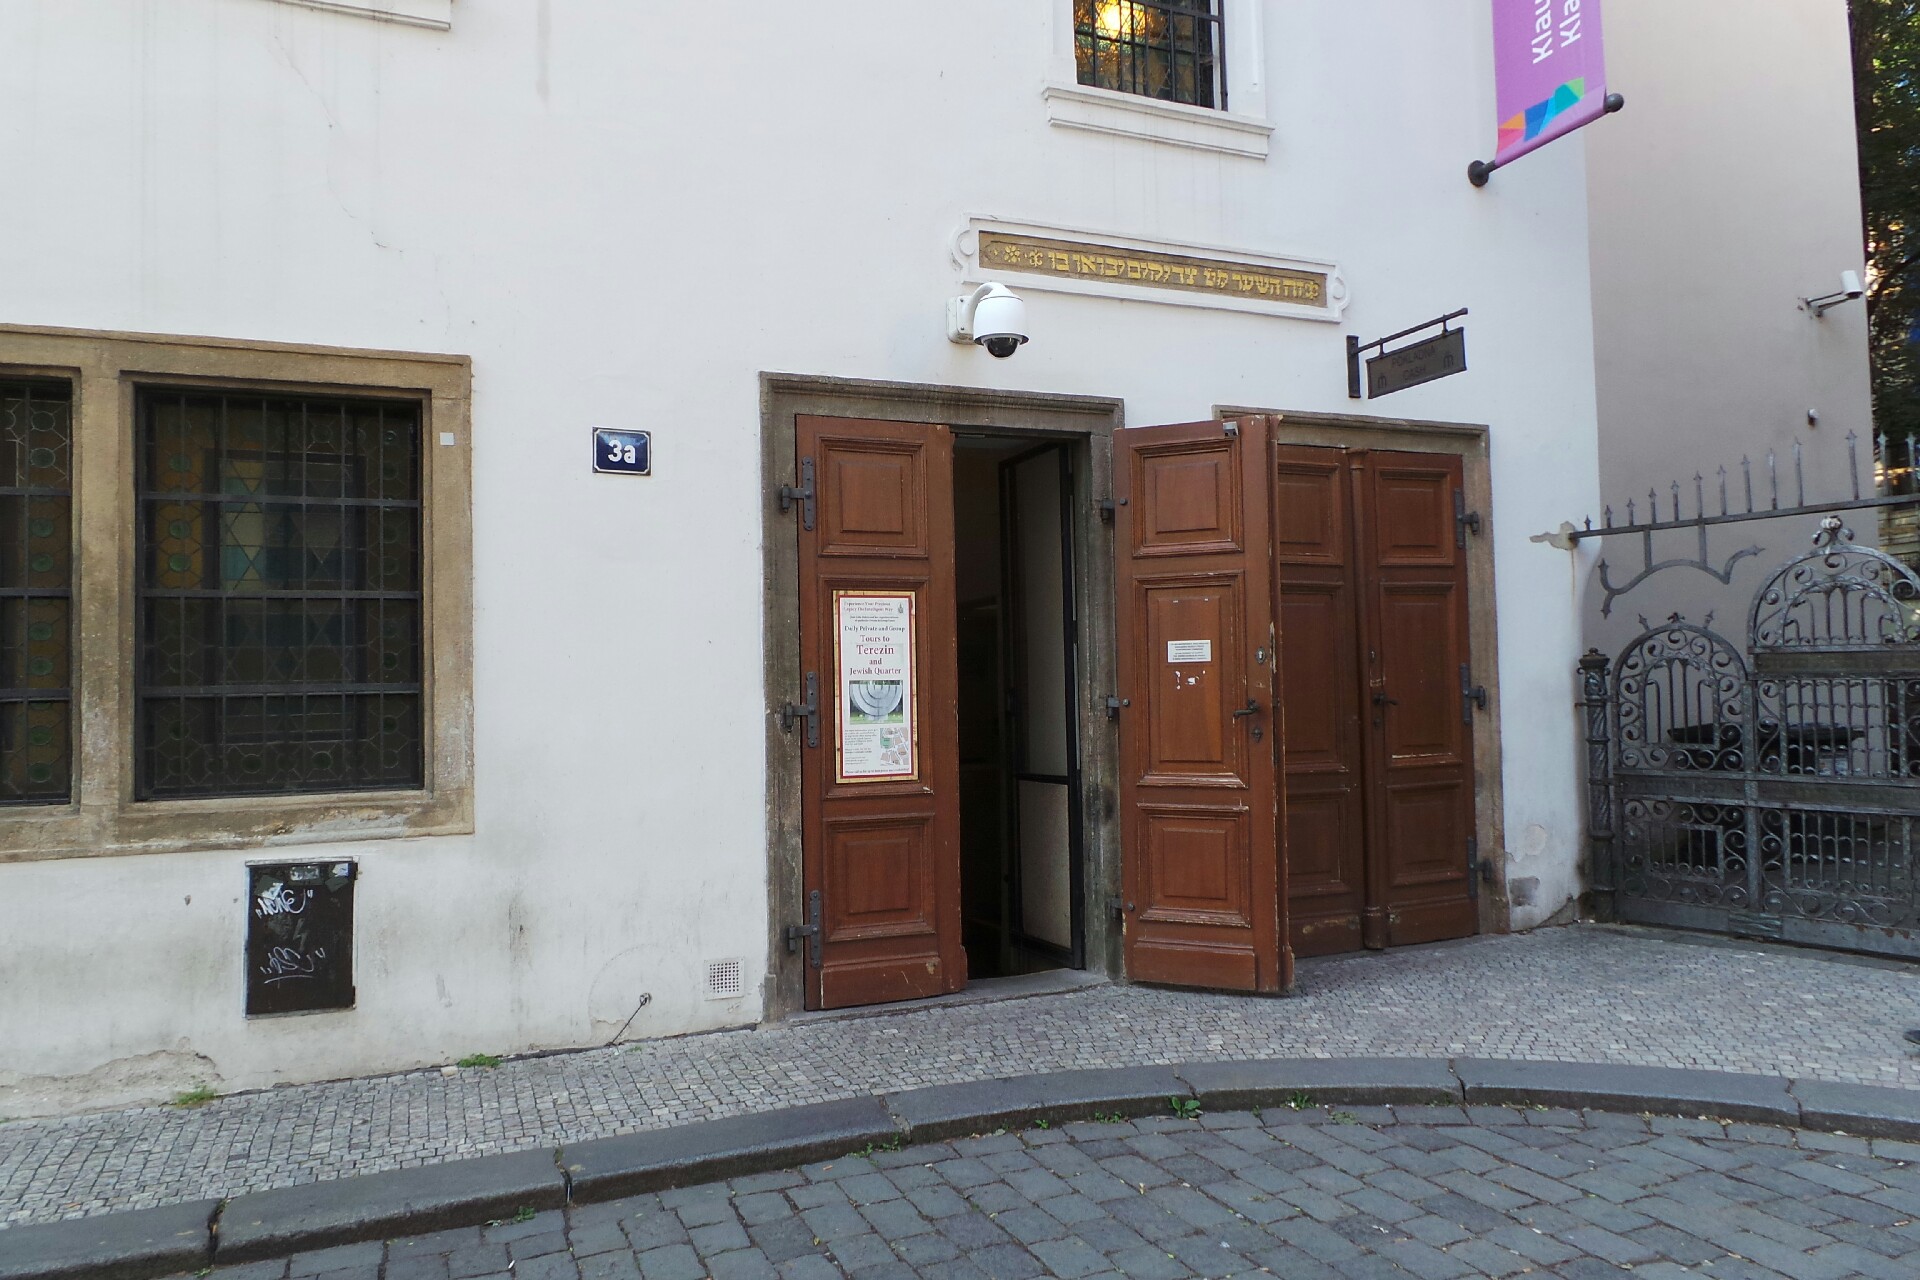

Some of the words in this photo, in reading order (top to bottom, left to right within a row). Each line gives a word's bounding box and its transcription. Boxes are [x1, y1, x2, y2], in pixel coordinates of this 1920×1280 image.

[1047, 251, 1070, 271] בו
[1127, 260, 1197, 285] צדיקים
[607, 439, 636, 464] 3a
[856, 645, 894, 654] Terezin
[874, 667, 901, 675] Quarter
